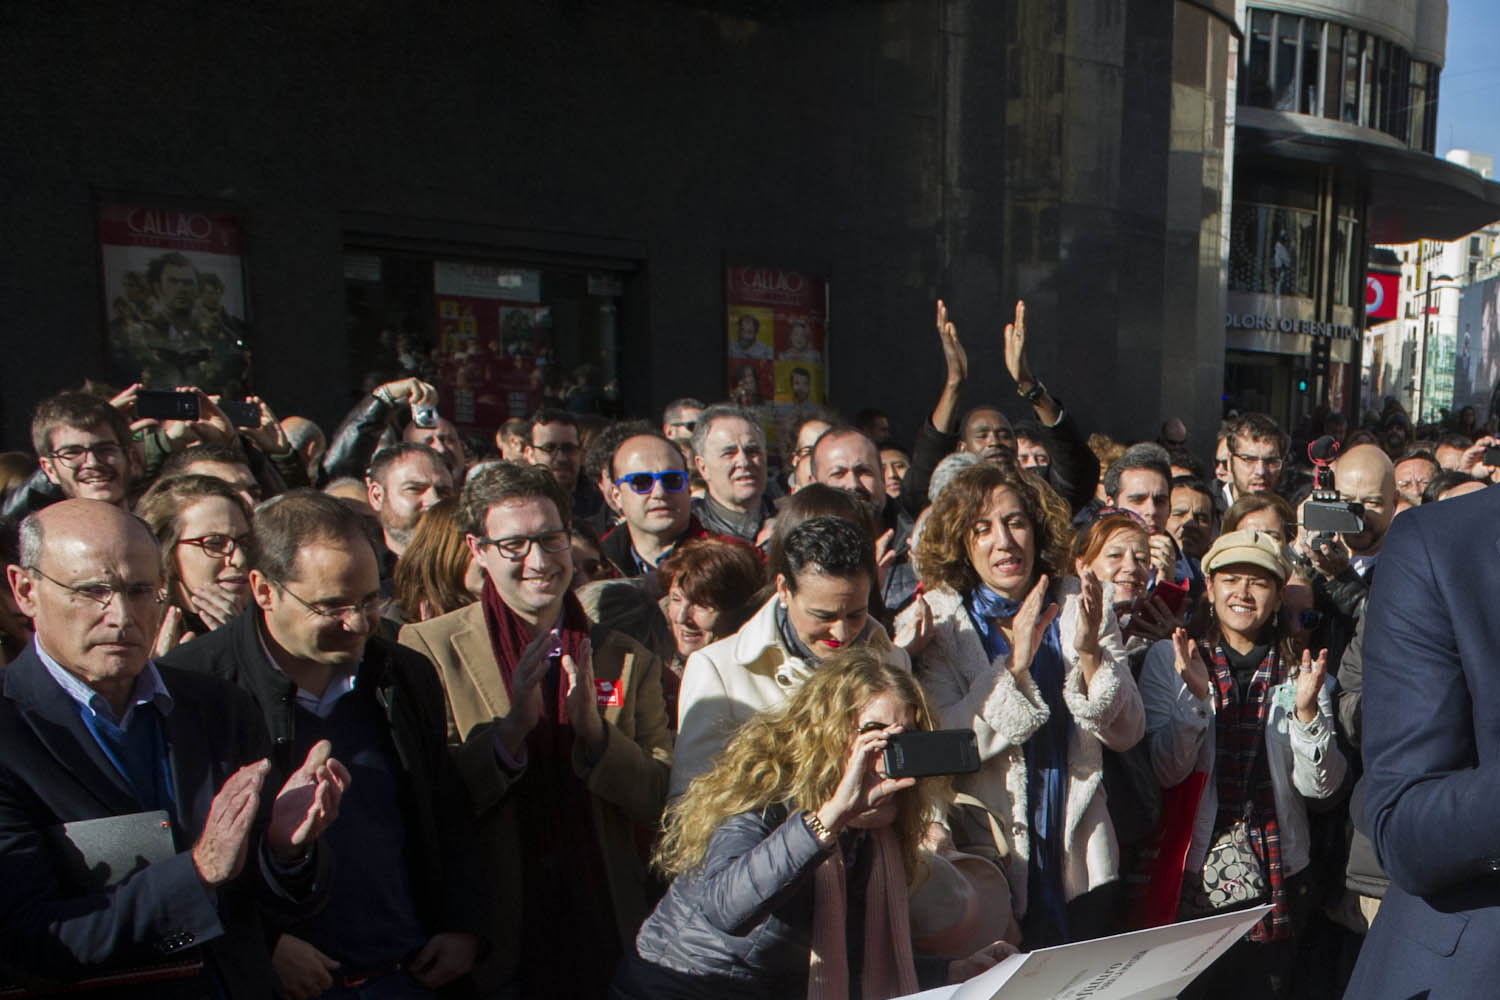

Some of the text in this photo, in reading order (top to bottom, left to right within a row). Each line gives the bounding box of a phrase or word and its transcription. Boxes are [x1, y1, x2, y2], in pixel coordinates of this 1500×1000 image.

[127, 207, 214, 240] CALLAO
[743, 266, 803, 291] CALLAO
[1225, 313, 1360, 341] OLORS OF BENETTON
